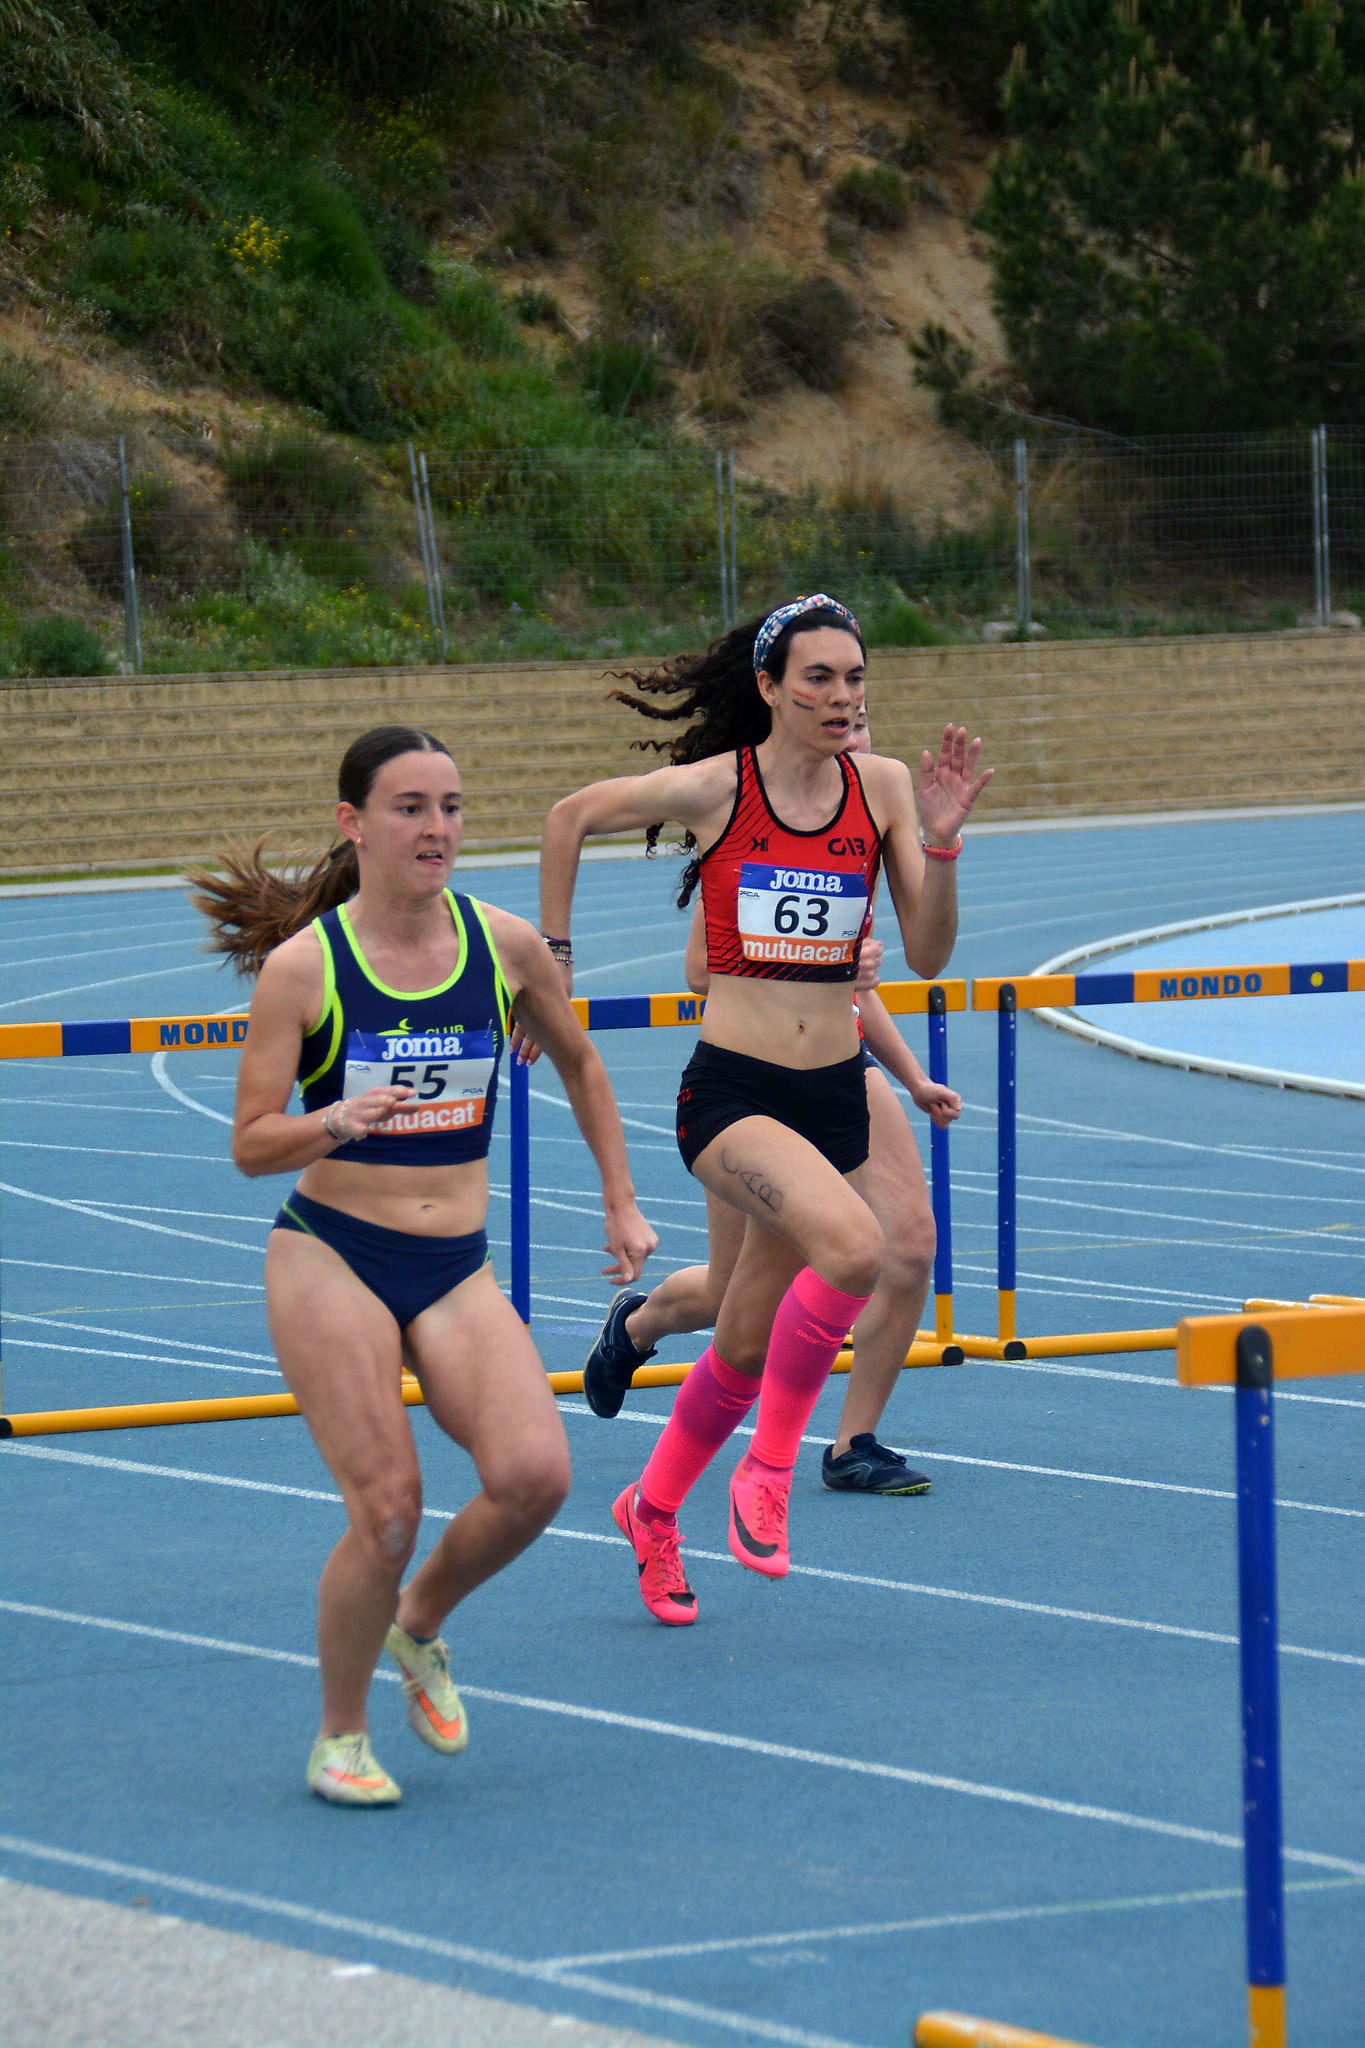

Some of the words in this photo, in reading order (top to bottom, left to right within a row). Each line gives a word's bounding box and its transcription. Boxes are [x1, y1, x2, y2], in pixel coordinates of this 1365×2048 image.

[774, 895, 830, 937] 63
[743, 940, 848, 962] mutuacat
[1160, 973, 1262, 998] MONDO
[160, 1020, 249, 1046] MOND
[390, 1064, 449, 1101] 55
[367, 1101, 476, 1131] utuacat
